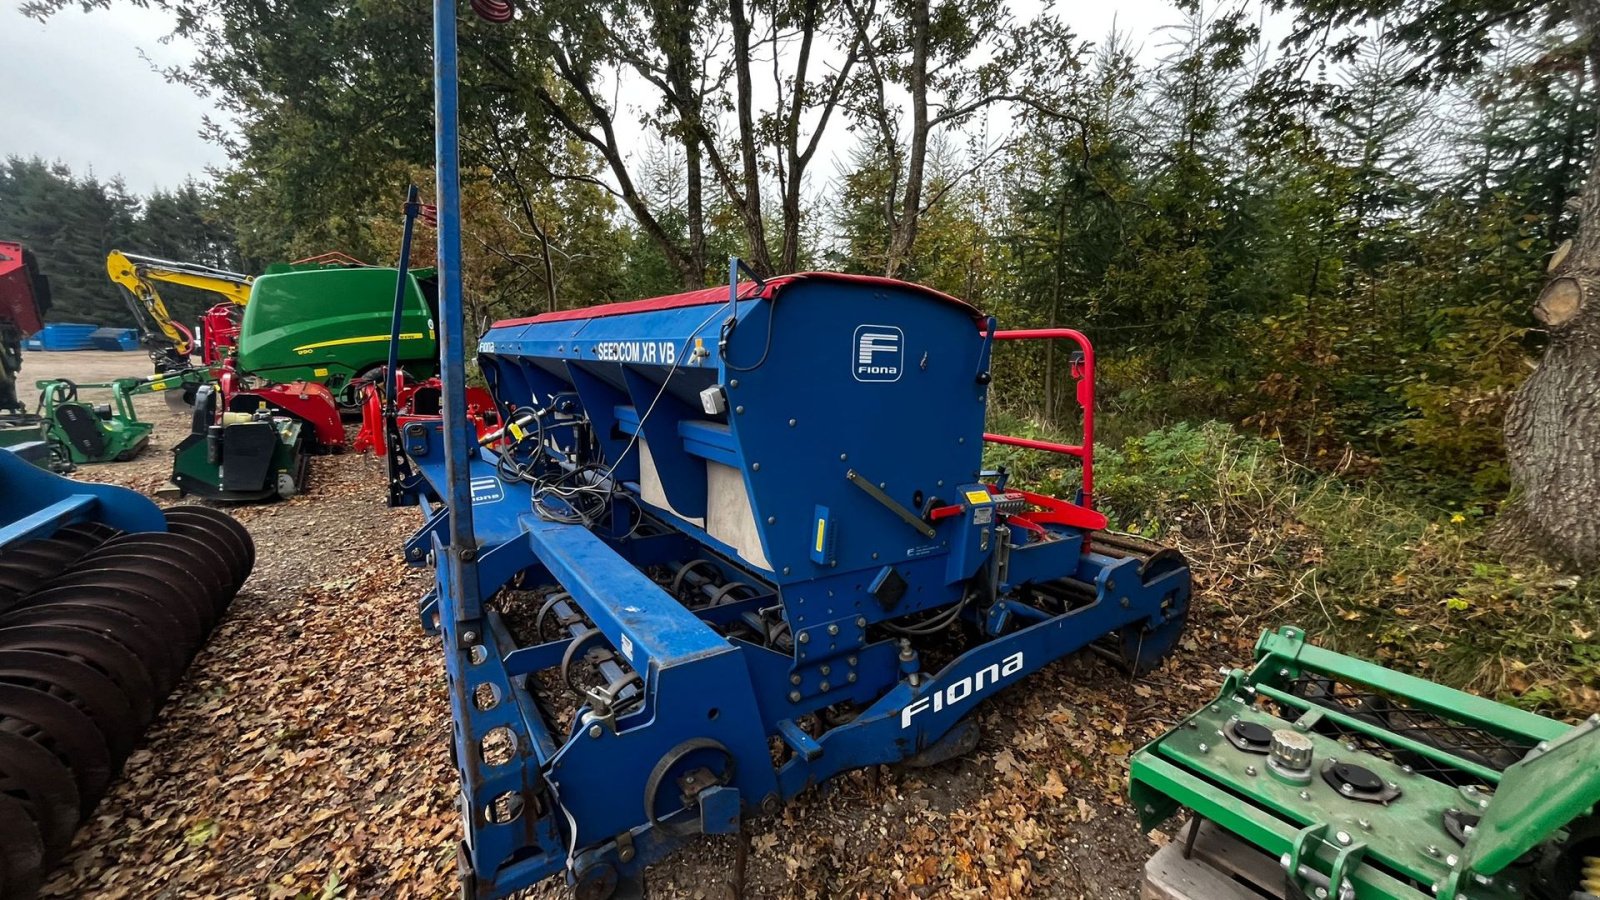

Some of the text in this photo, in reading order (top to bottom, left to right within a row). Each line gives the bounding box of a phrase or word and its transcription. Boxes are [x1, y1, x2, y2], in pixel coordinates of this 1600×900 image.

[598, 341, 675, 364] SEEDCOM XR VB
[901, 651, 1024, 729] Fiona
